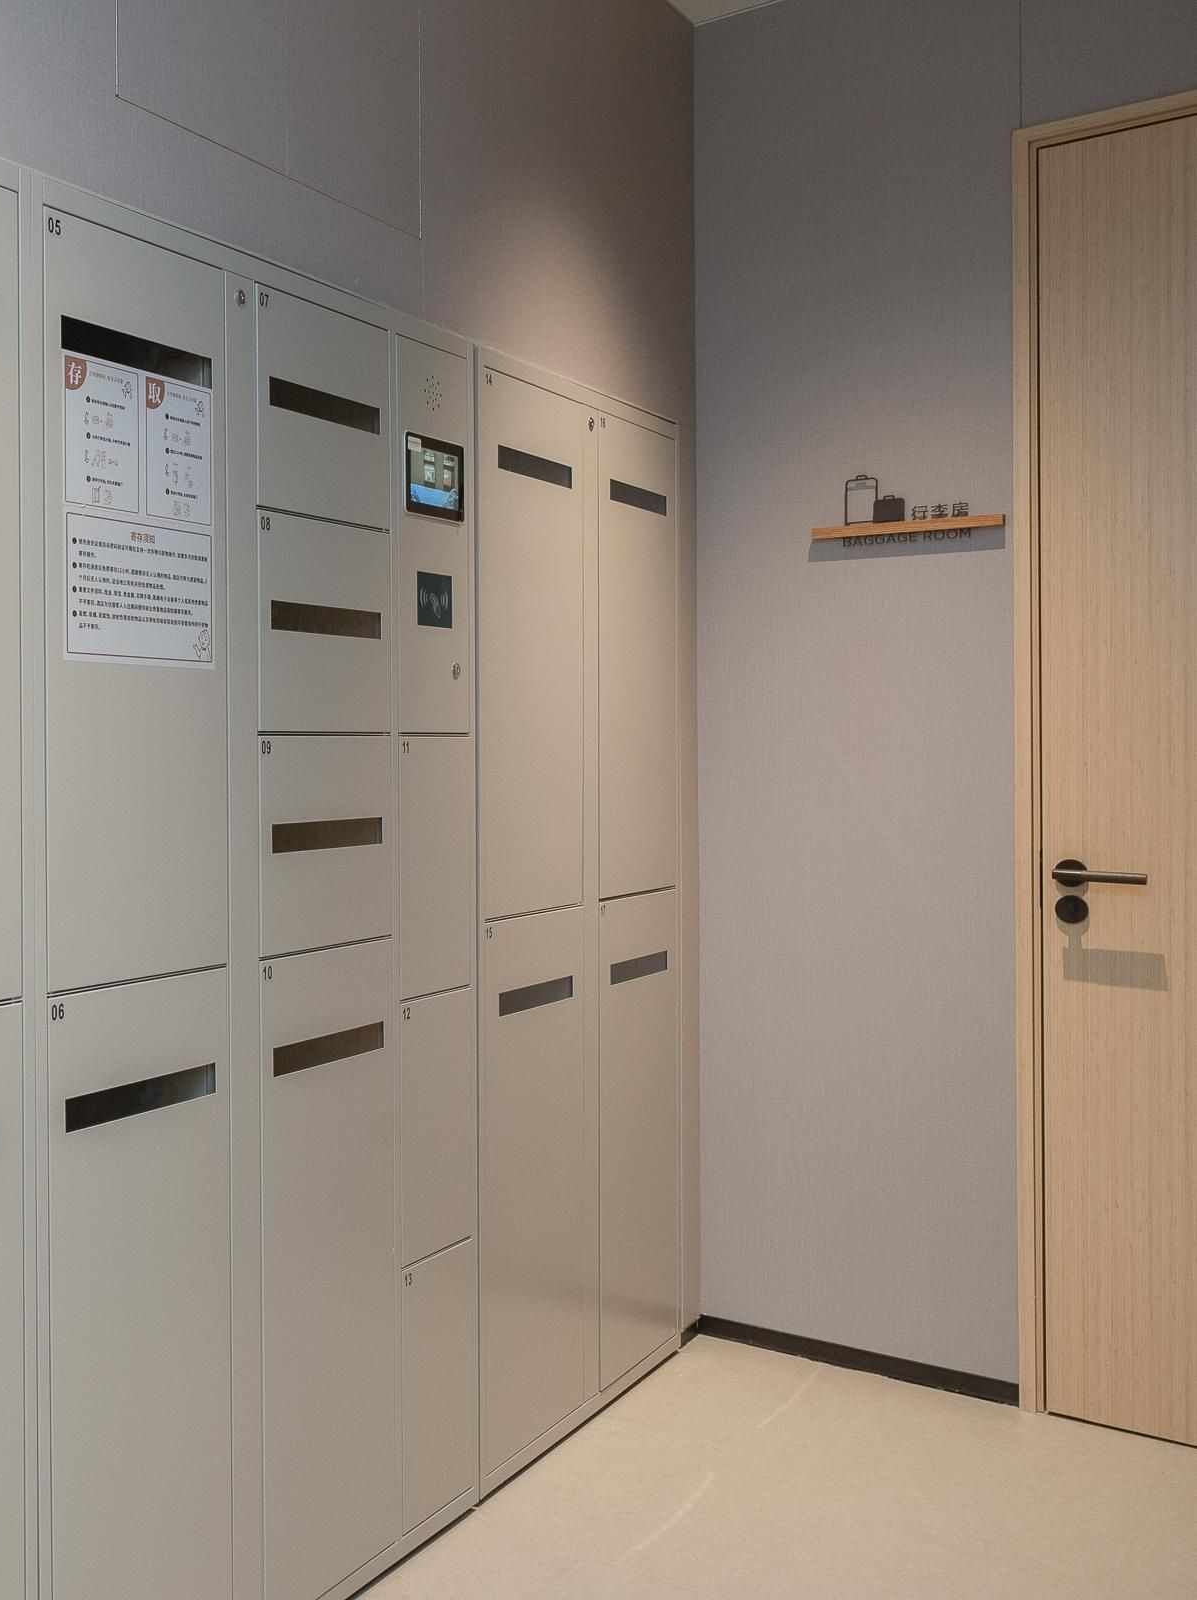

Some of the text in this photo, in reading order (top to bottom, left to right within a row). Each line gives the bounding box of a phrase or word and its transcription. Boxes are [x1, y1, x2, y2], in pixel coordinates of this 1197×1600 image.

[47, 216, 61, 236] 05
[259, 292, 269, 308] 07
[67, 361, 82, 386] 存
[485, 373, 492, 385] 14
[147, 382, 162, 405] 取
[910, 501, 969, 521] 行李房
[260, 516, 271, 531] 08
[130, 531, 156, 544] 寄存须知
[842, 528, 972, 548] BAGGAGE ROOM
[261, 740, 271, 755] 09
[402, 741, 410, 754] 11
[485, 927, 493, 939] 15
[262, 965, 273, 980] 10
[51, 1003, 65, 1021] 06
[402, 1007, 411, 1021] 12
[404, 1273, 413, 1287] 13
